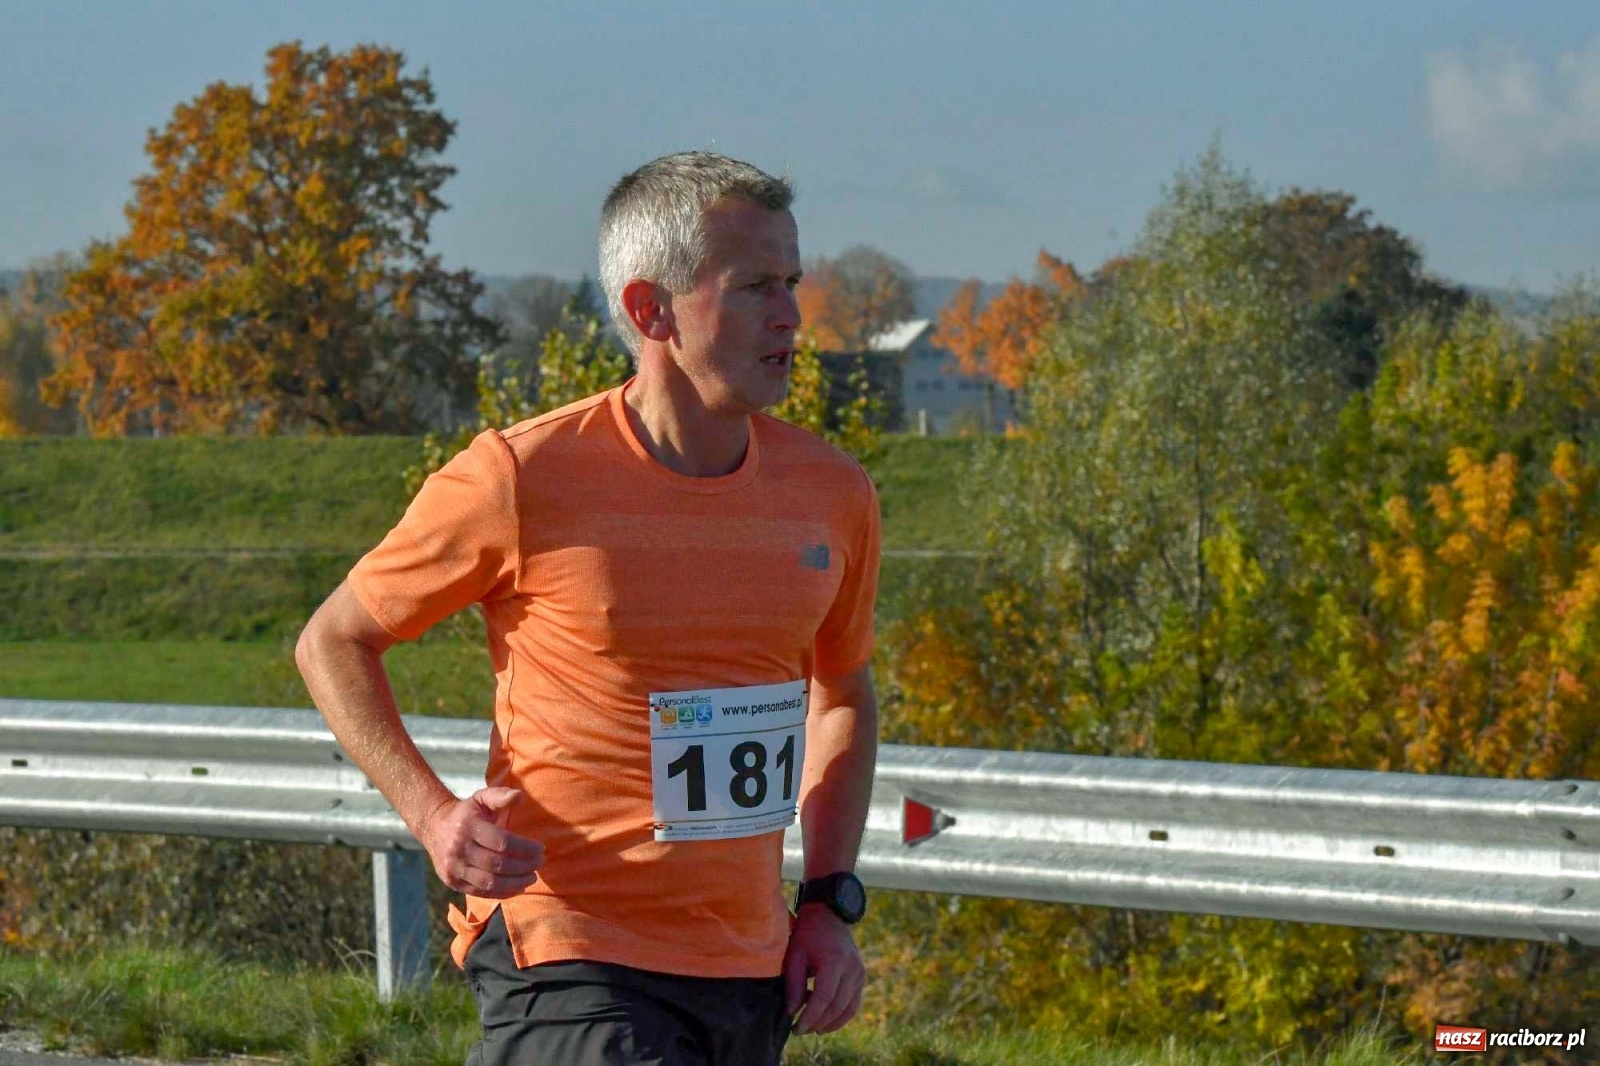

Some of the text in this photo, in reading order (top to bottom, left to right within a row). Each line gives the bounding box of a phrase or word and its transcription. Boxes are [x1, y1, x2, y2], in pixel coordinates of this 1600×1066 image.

[659, 694, 712, 707] PersonalBest
[721, 697, 803, 717] www.personalbest.pl
[667, 734, 795, 812] 181
